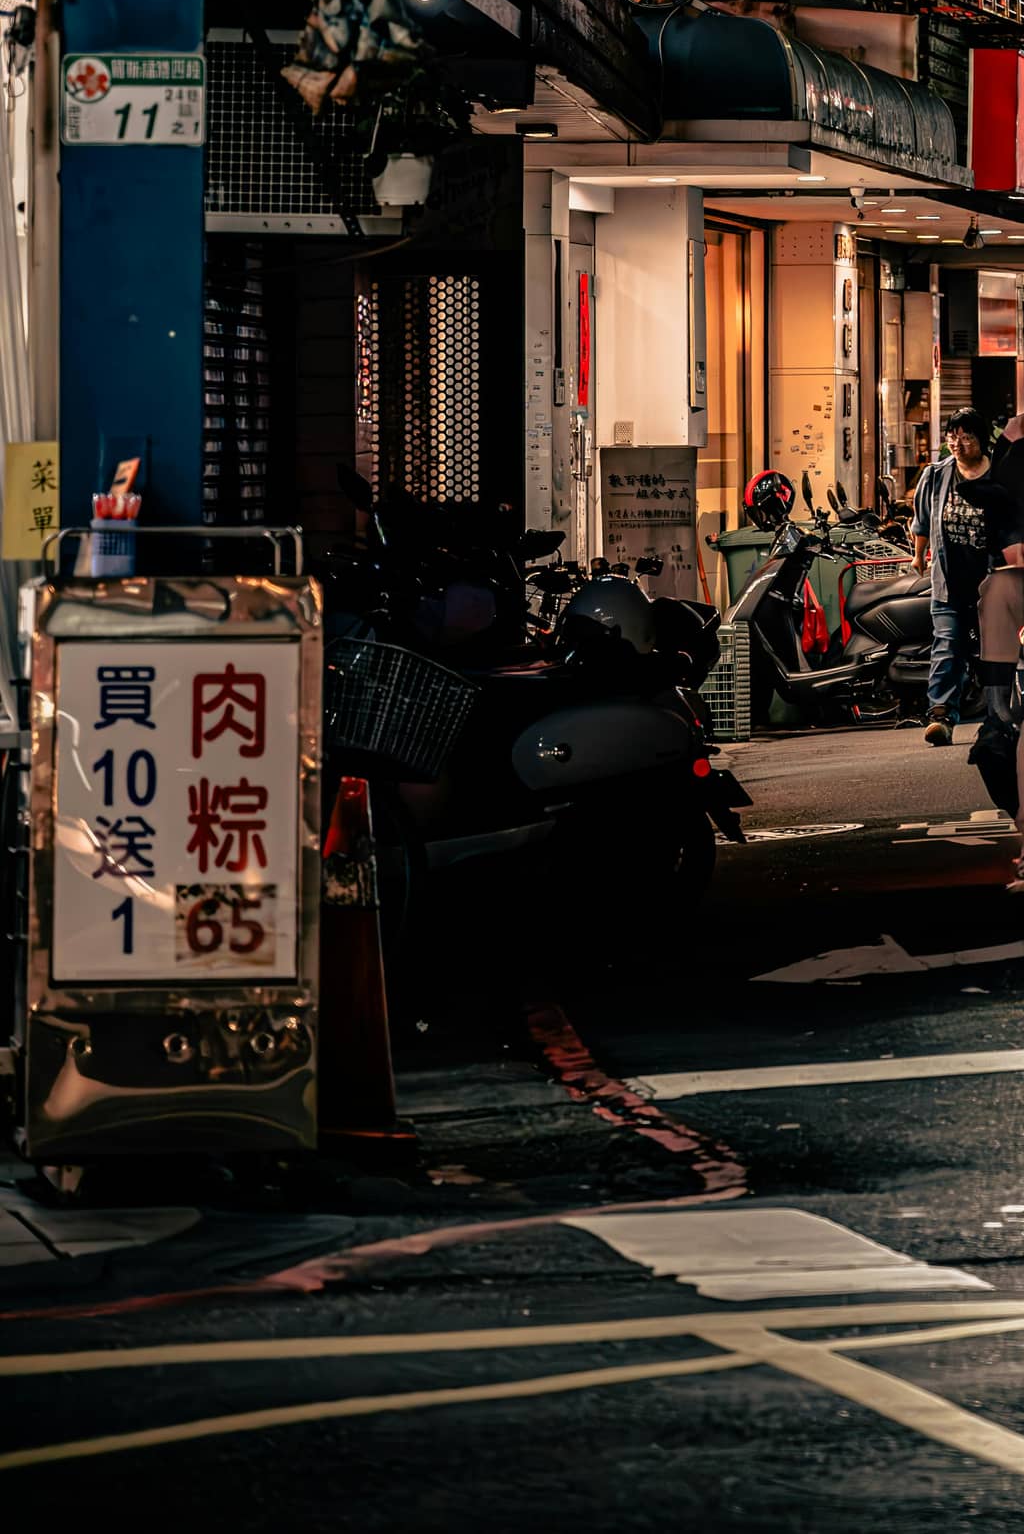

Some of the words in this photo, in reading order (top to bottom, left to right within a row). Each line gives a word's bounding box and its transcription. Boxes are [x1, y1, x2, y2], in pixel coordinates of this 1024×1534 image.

[114, 102, 159, 140] 11
[28, 459, 58, 539] 菜單
[186, 663, 268, 874] 肉粽
[186, 898, 265, 954] 65
